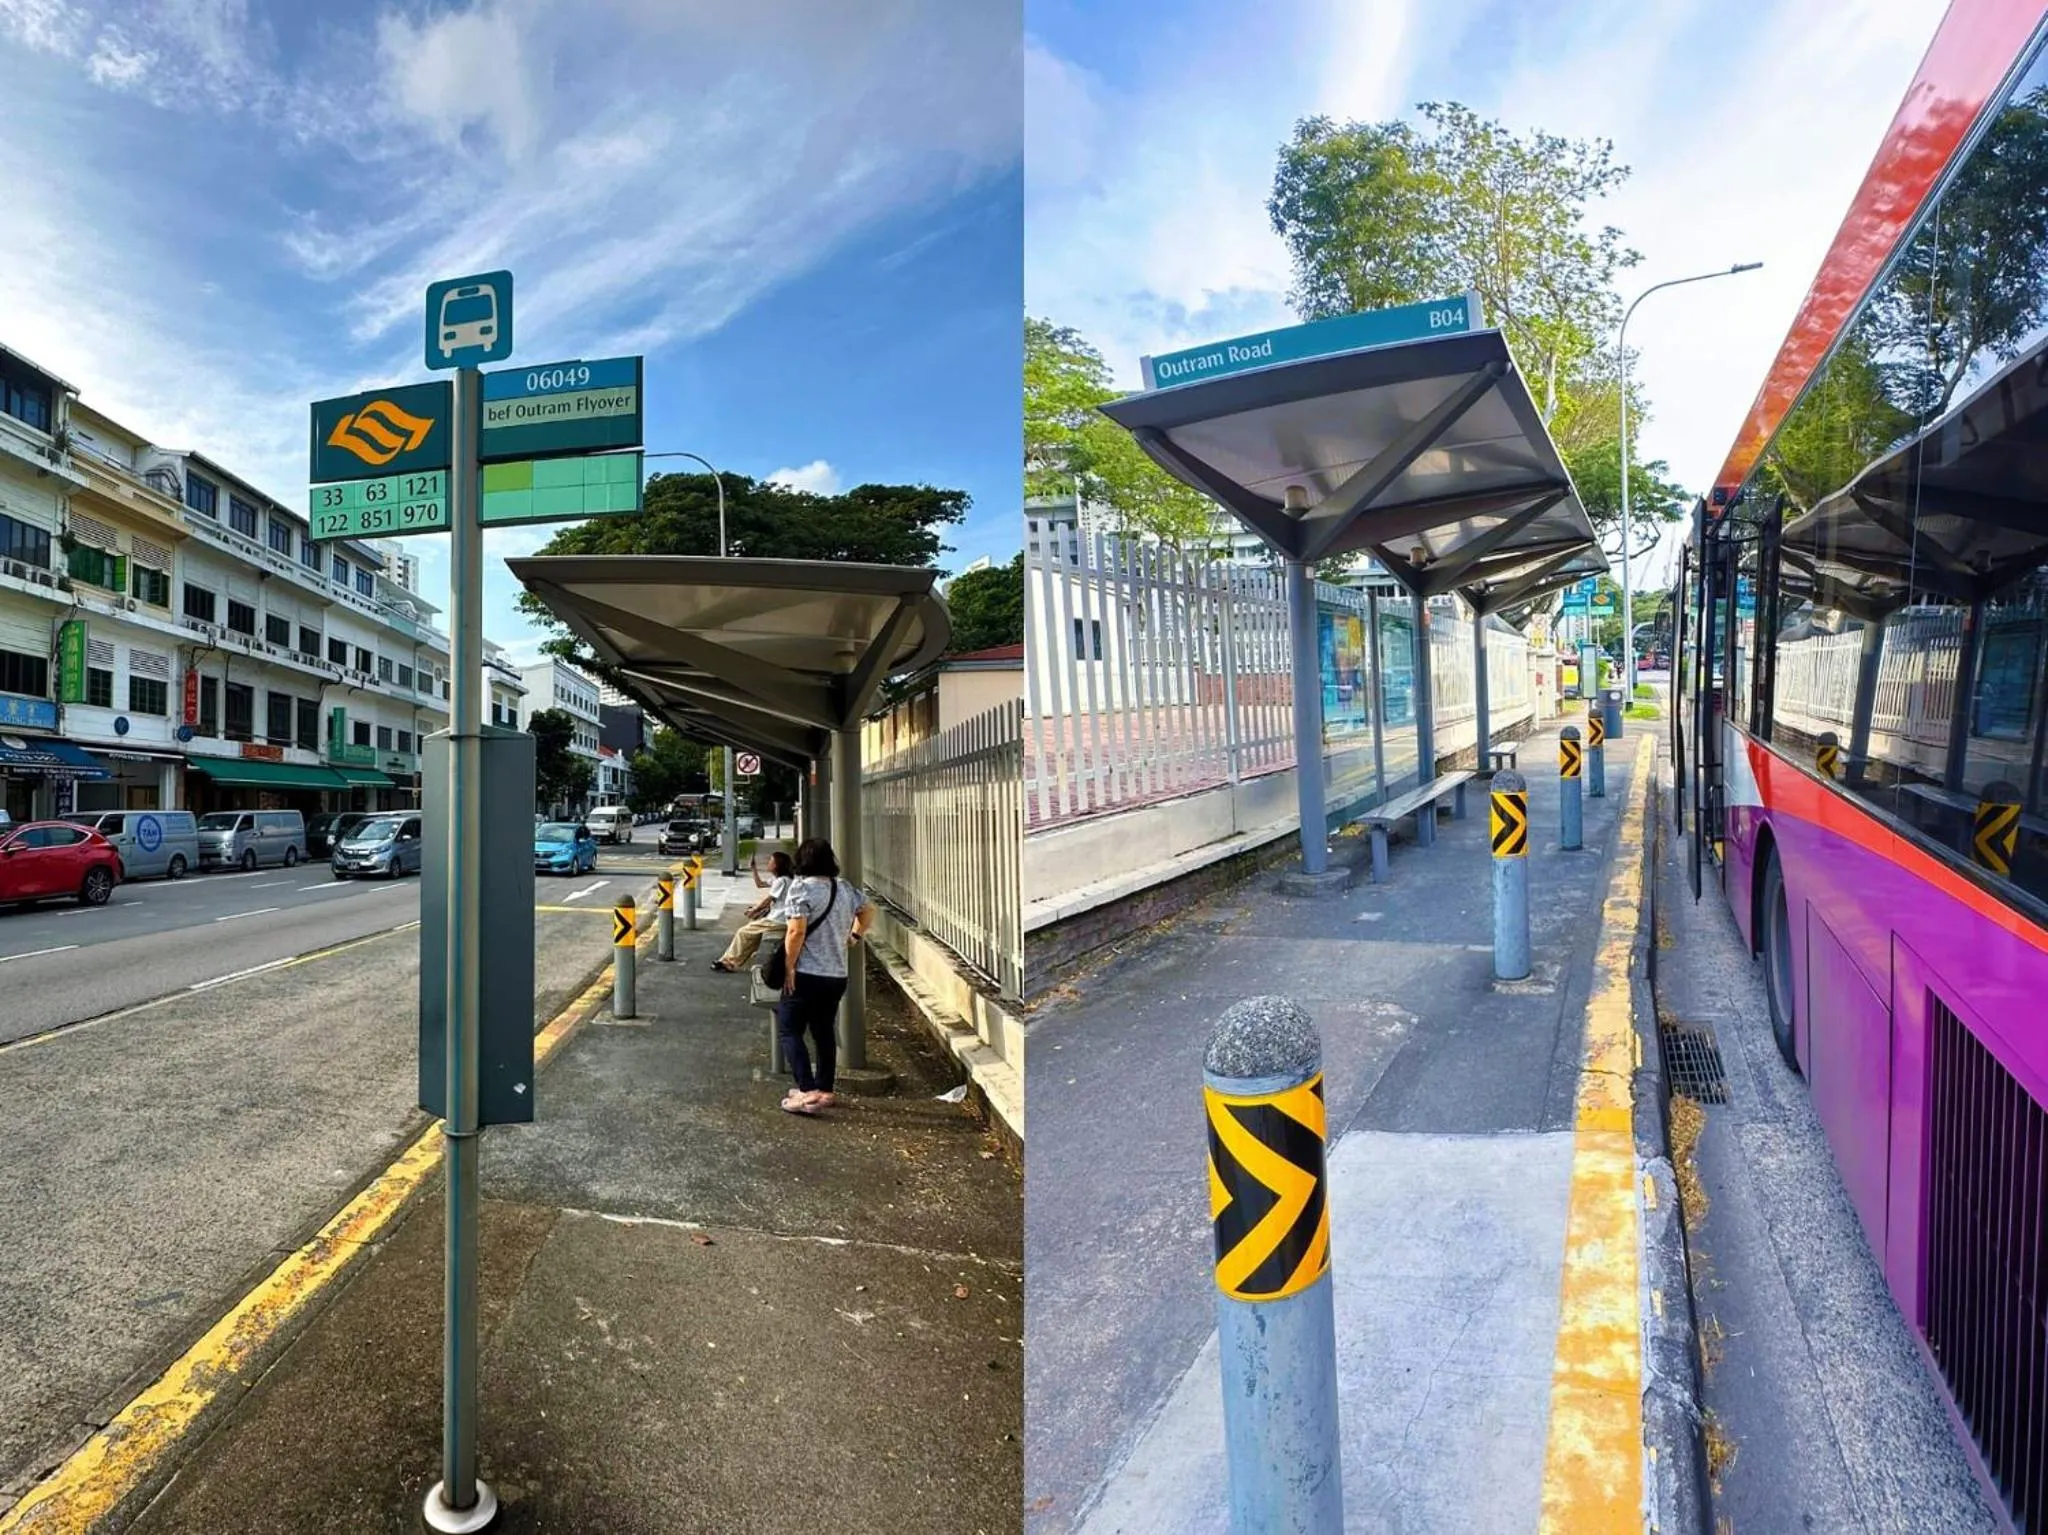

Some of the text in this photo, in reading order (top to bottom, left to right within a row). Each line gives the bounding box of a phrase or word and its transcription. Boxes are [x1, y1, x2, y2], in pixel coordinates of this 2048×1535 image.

[1429, 308, 1465, 329] B04
[1159, 339, 1273, 378] Outram Road
[526, 366, 591, 392] 06049
[488, 394, 631, 422] bef Outram Flyover
[322, 475, 438, 507] 33 63 121
[318, 502, 438, 534] 122 851 970
